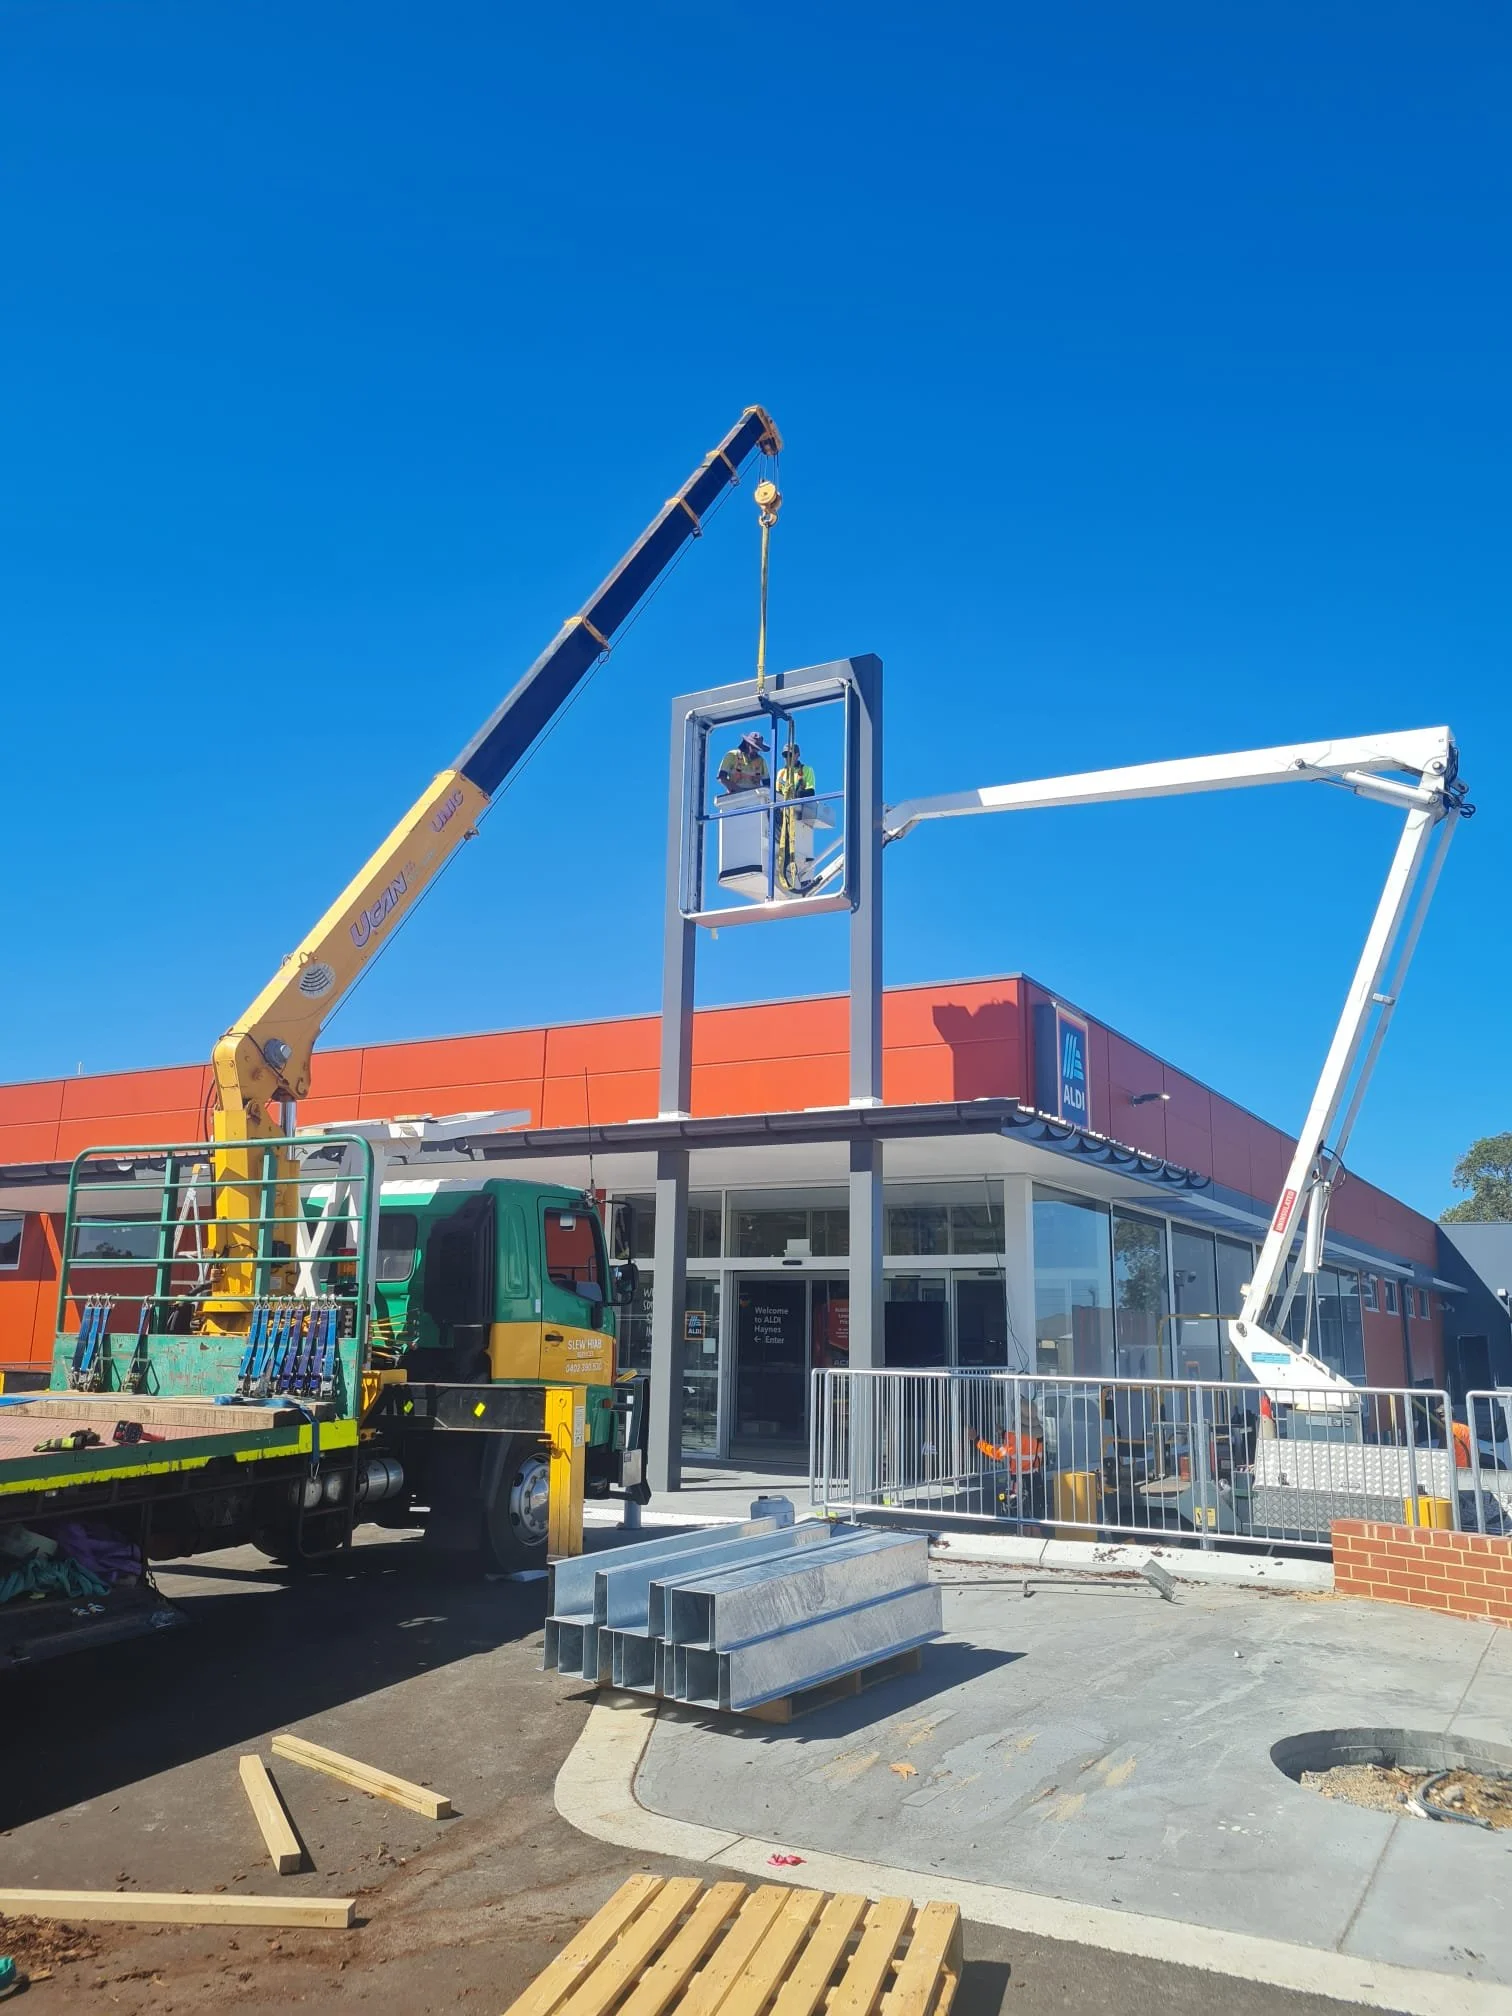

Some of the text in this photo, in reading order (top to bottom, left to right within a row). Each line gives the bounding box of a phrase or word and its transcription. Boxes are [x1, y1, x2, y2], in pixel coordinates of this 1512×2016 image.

[1063, 1084, 1086, 1112] ALDI
[1276, 1190, 1295, 1232] UNINSULATED
[754, 1305, 789, 1315] Welcome
[754, 1315, 782, 1324] to ALDI
[754, 1325, 782, 1335] Haynes
[567, 1339, 586, 1350] SLEW
[765, 1335, 785, 1344] Enter
